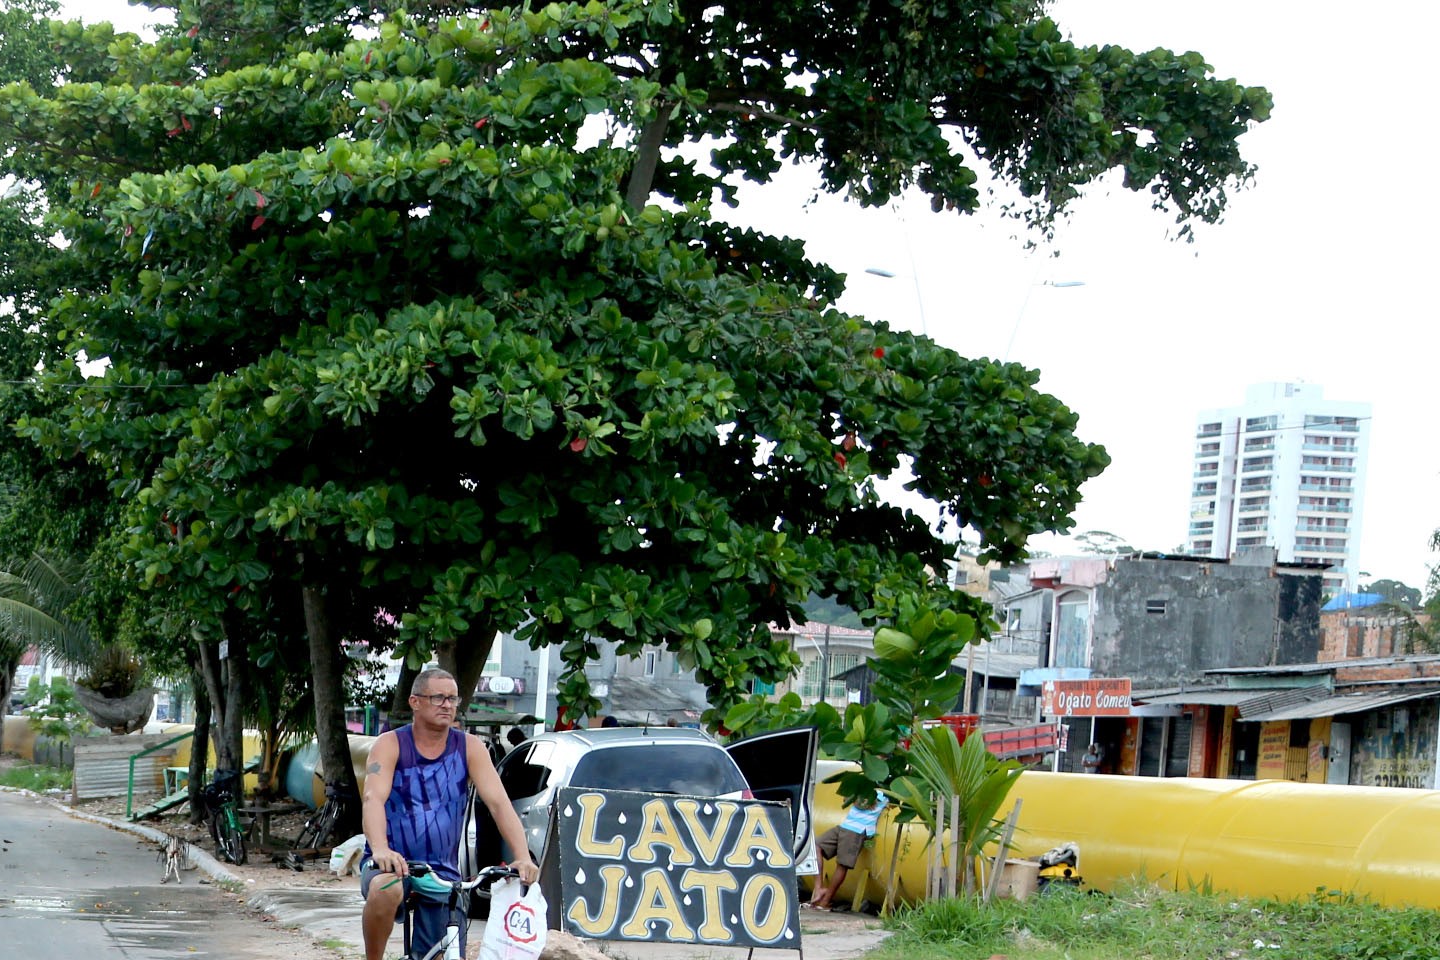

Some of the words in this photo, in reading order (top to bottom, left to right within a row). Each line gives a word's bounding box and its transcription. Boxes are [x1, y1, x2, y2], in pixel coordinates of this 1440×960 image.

[1096, 689, 1131, 709] Comeu
[576, 792, 793, 867] LAVA
[509, 910, 532, 936] C&A
[567, 864, 789, 944] JATO
